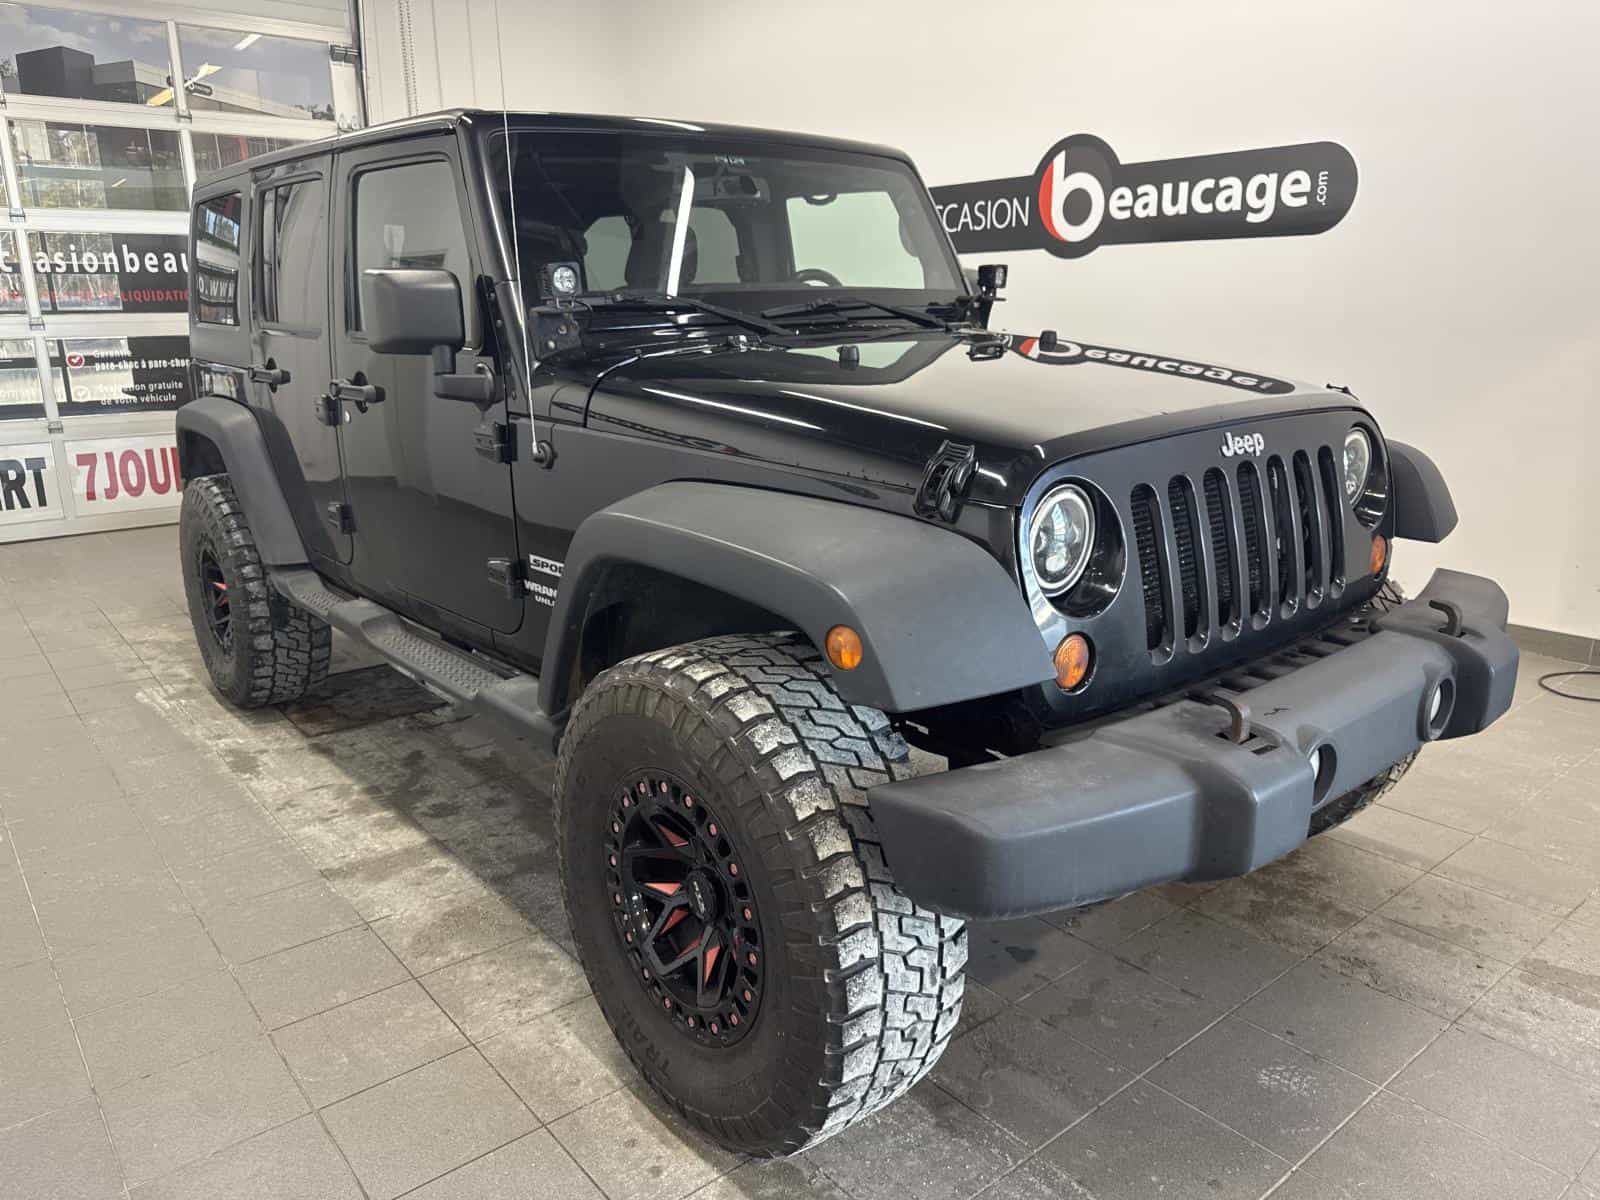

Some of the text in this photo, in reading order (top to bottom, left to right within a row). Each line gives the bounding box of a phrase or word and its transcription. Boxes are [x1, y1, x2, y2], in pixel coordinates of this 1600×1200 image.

[1039, 150, 1312, 242] beaucage
[139, 392, 176, 402] véhicule
[148, 380, 184, 392] gratuite
[1221, 432, 1265, 457] Jeep
[0, 456, 47, 511] RT
[524, 579, 557, 598] WRAN
